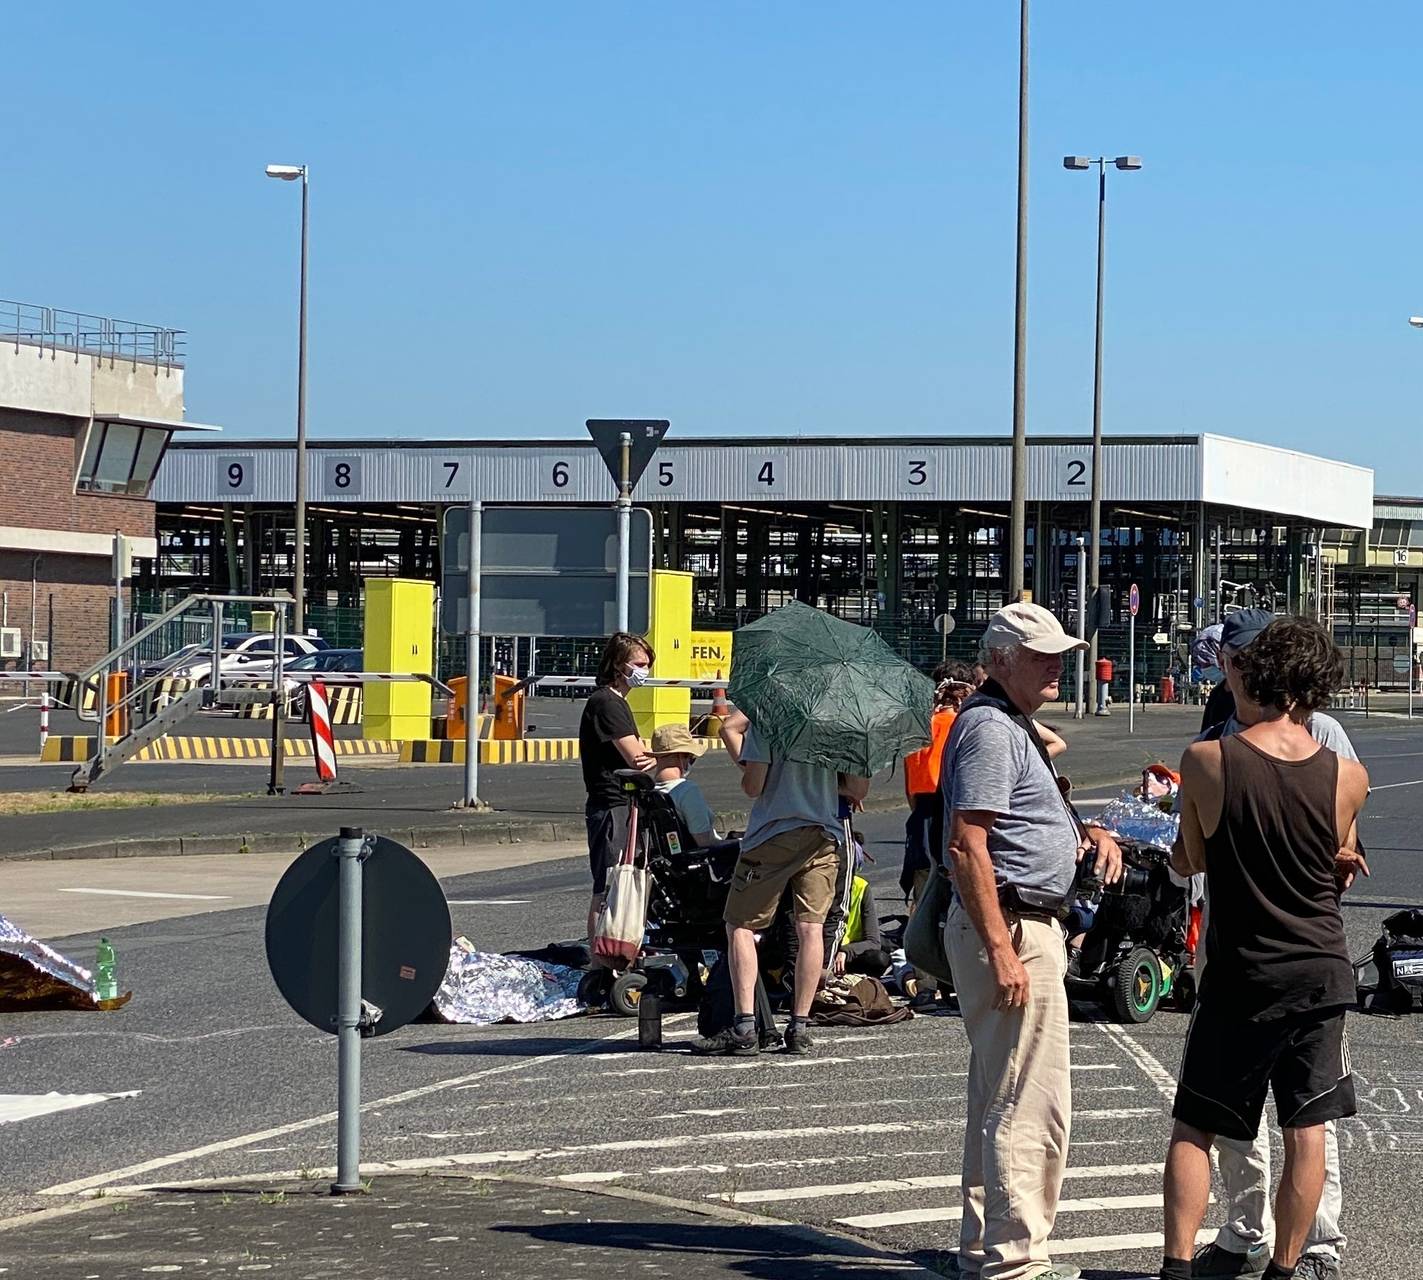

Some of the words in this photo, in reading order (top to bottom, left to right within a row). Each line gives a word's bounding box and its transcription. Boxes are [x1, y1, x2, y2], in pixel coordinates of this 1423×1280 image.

[227, 462, 244, 489] 9
[334, 462, 351, 489] 8
[443, 462, 460, 488] 7
[552, 461, 569, 488] 6
[658, 462, 674, 487] 5
[757, 461, 775, 486] 4
[908, 460, 927, 486] 3
[1067, 460, 1086, 486] 2
[691, 646, 726, 661] FEN,
